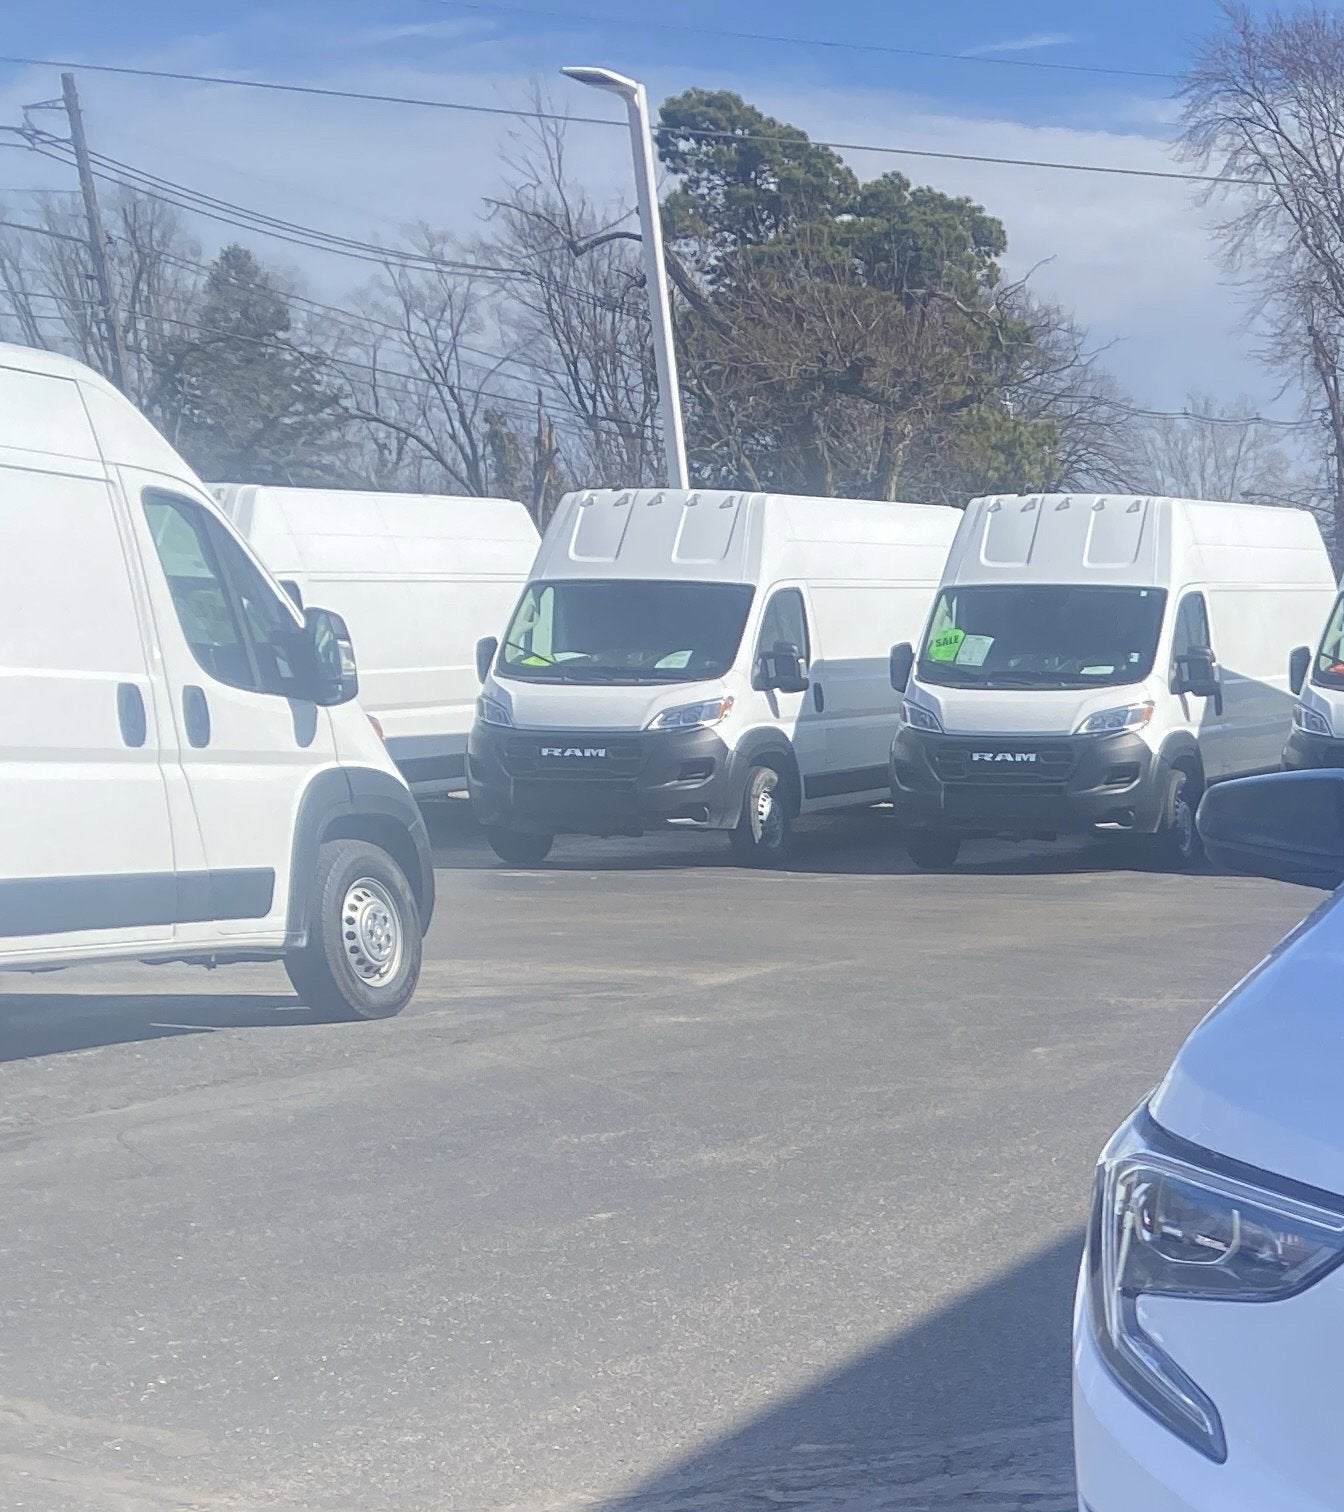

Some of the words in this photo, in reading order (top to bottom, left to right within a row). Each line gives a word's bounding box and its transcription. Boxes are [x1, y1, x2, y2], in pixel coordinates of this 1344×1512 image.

[936, 635, 960, 648] SALE
[540, 747, 606, 757] RAM
[972, 752, 1037, 762] RAM
